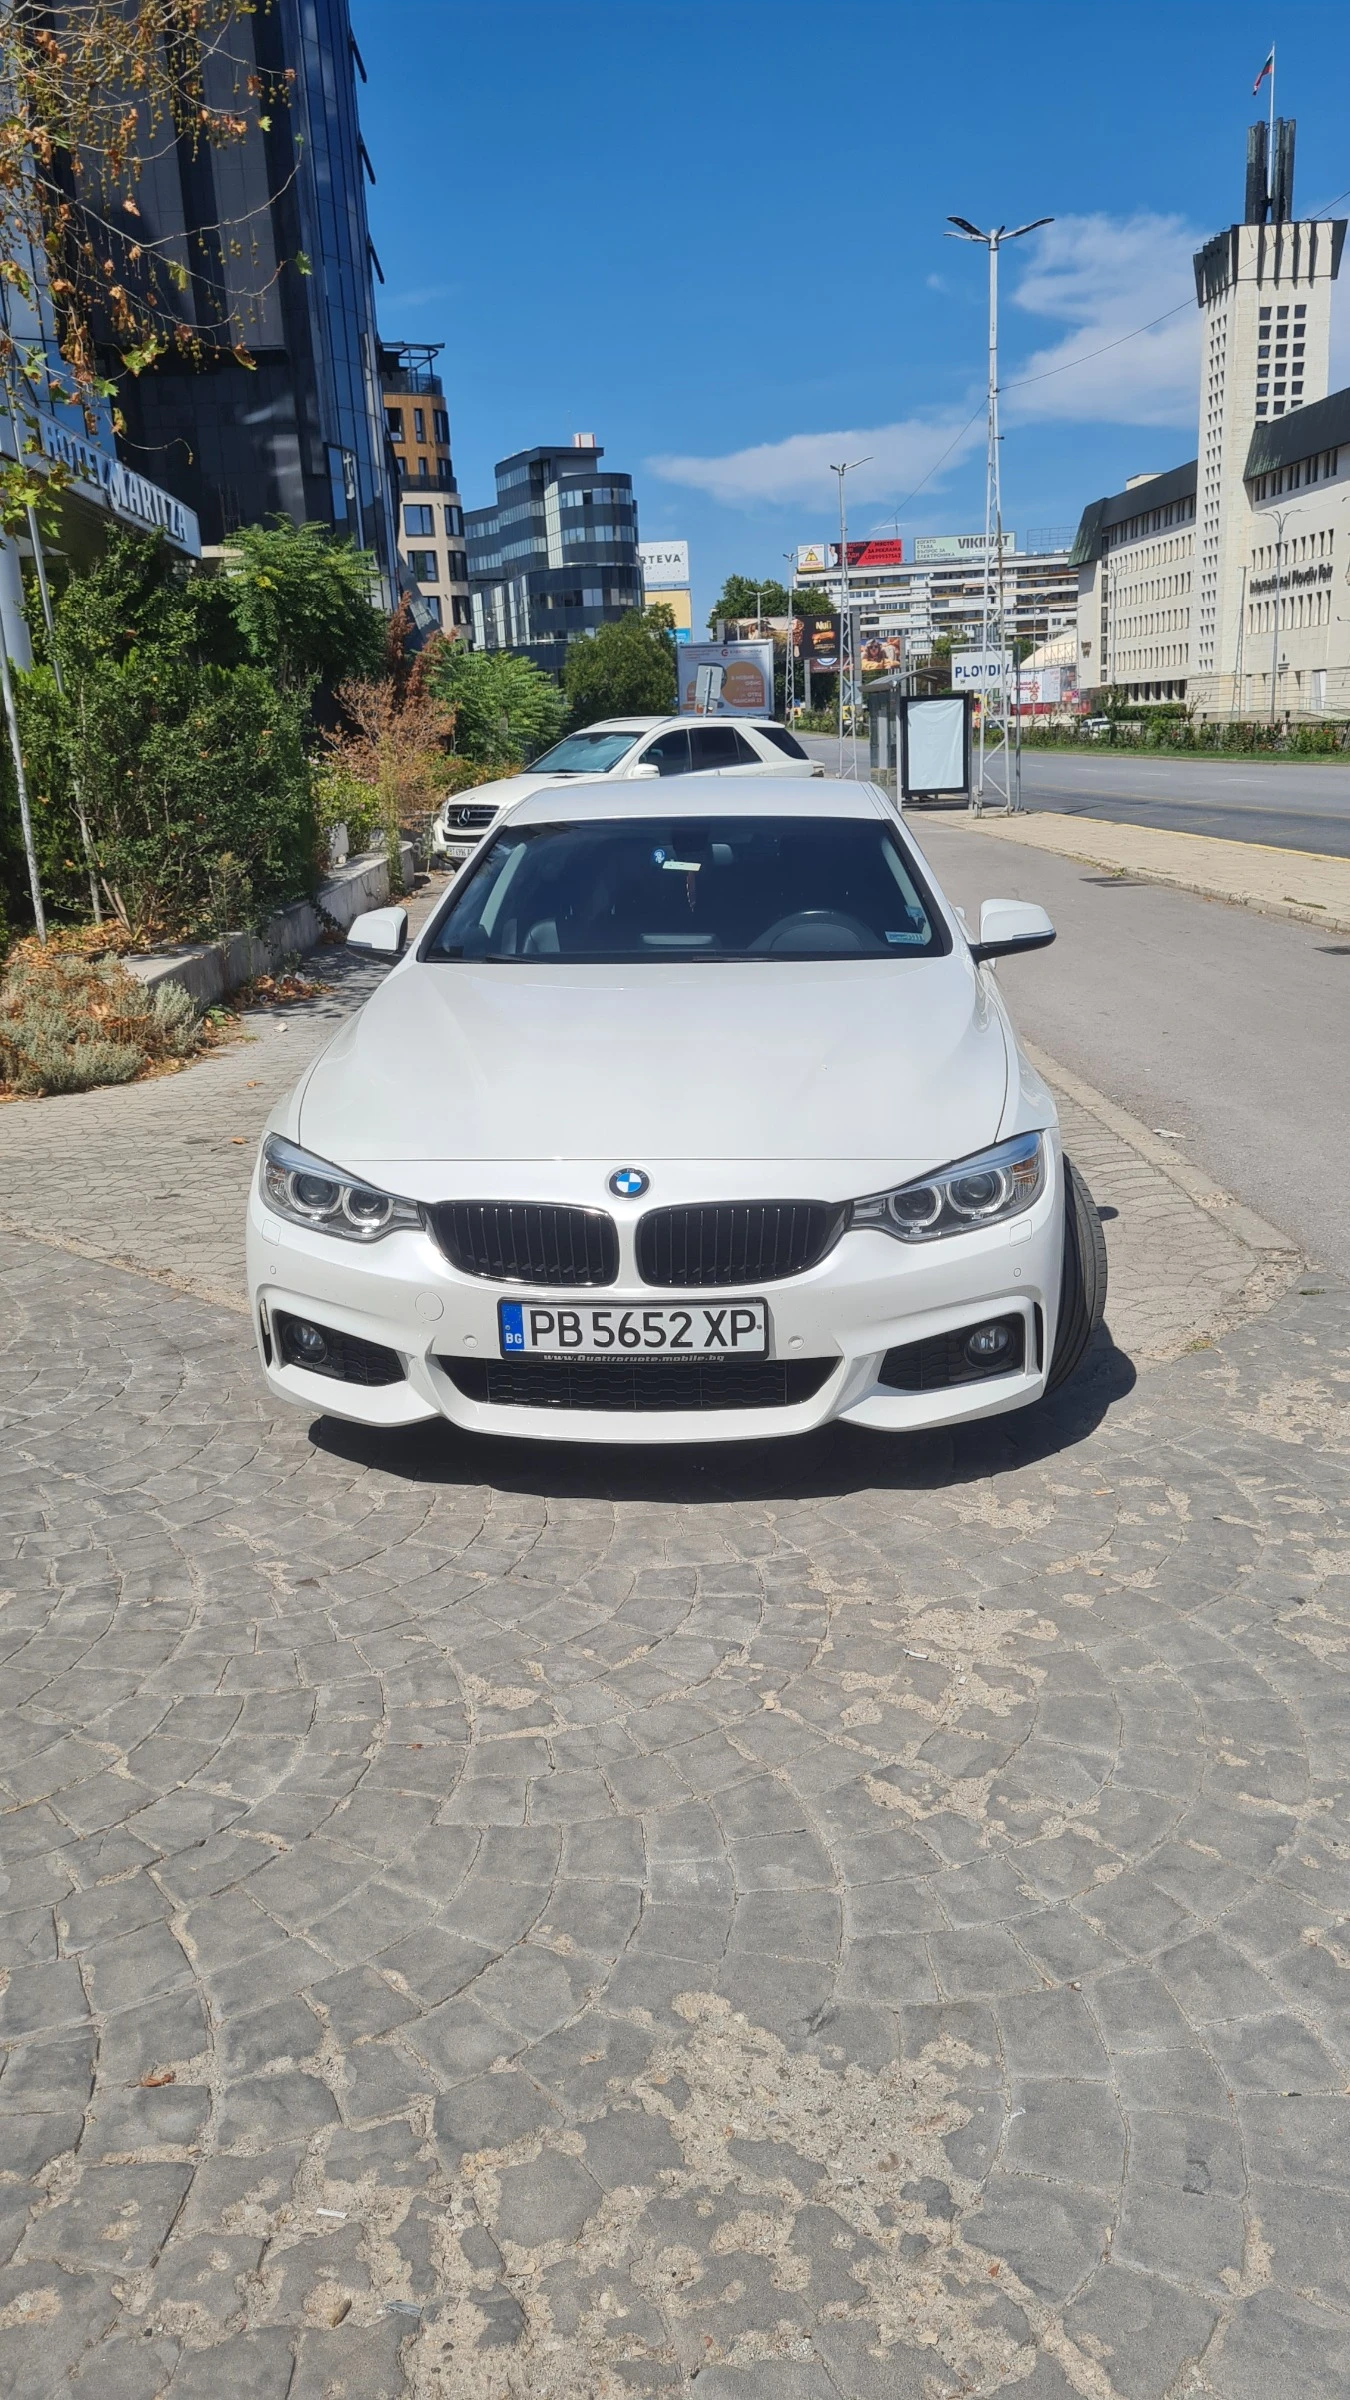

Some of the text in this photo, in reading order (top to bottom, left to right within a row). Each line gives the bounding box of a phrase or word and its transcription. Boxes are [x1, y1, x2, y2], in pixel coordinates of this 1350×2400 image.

[108, 459, 188, 542] MARITZA
[1319, 562, 1333, 581] Fair
[505, 1332, 523, 1344] BG
[530, 1309, 756, 1348] PB 5652 XP
